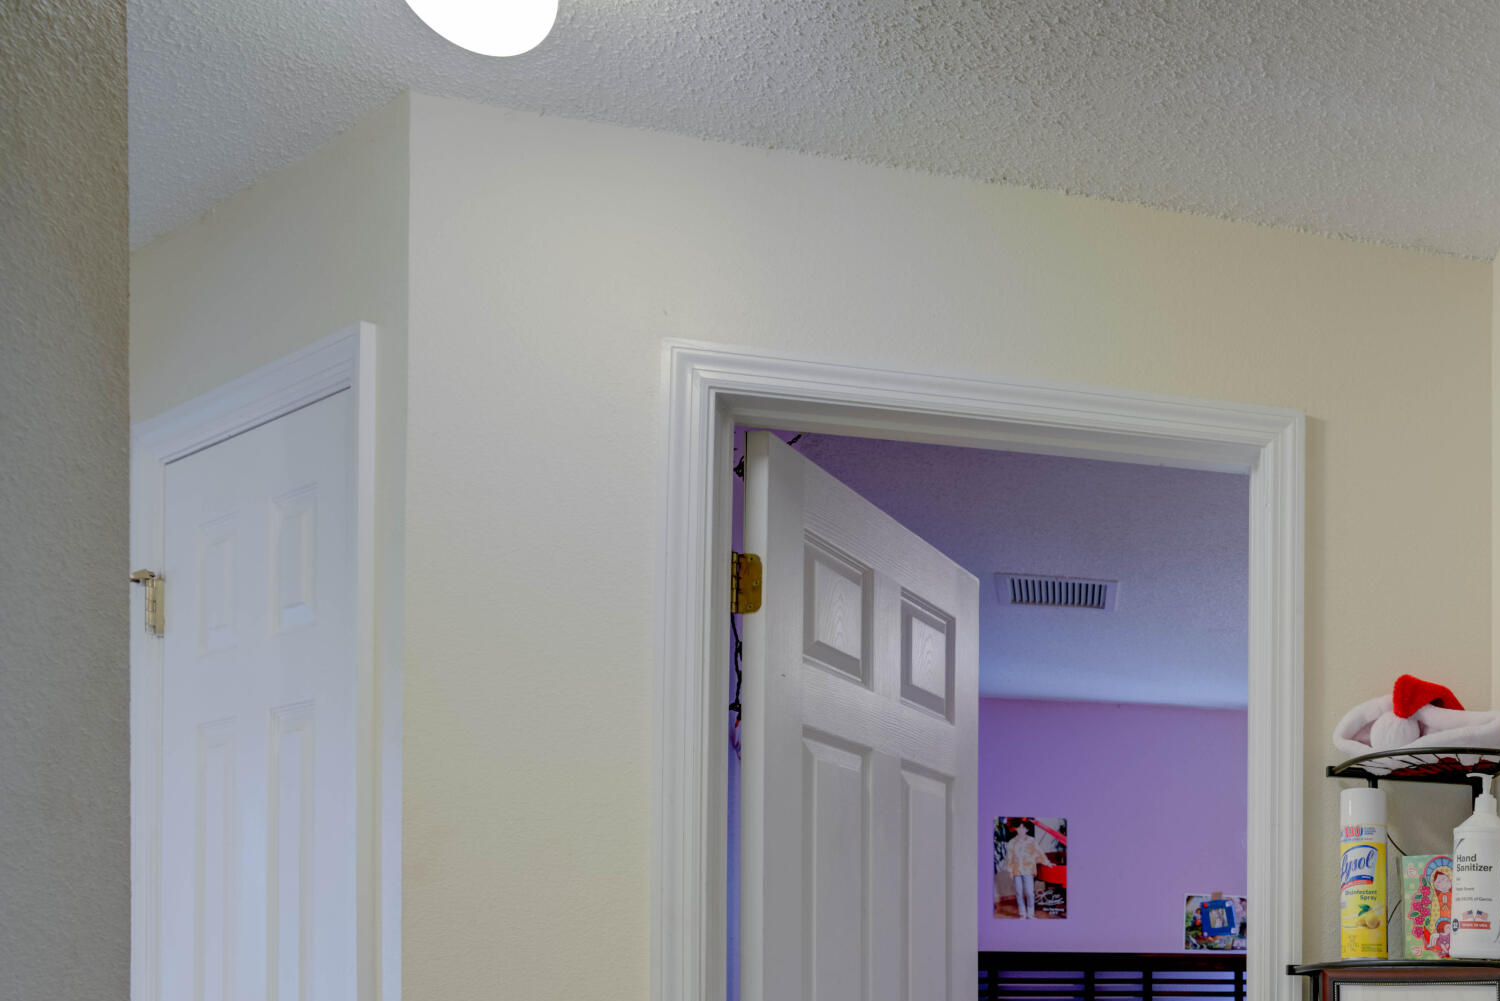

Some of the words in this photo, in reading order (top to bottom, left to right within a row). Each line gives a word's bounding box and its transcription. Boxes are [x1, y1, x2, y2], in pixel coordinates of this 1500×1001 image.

[1456, 854, 1477, 863] Hand
[1340, 850, 1376, 881] Lysol
[1456, 863, 1493, 873] Sanitizer
